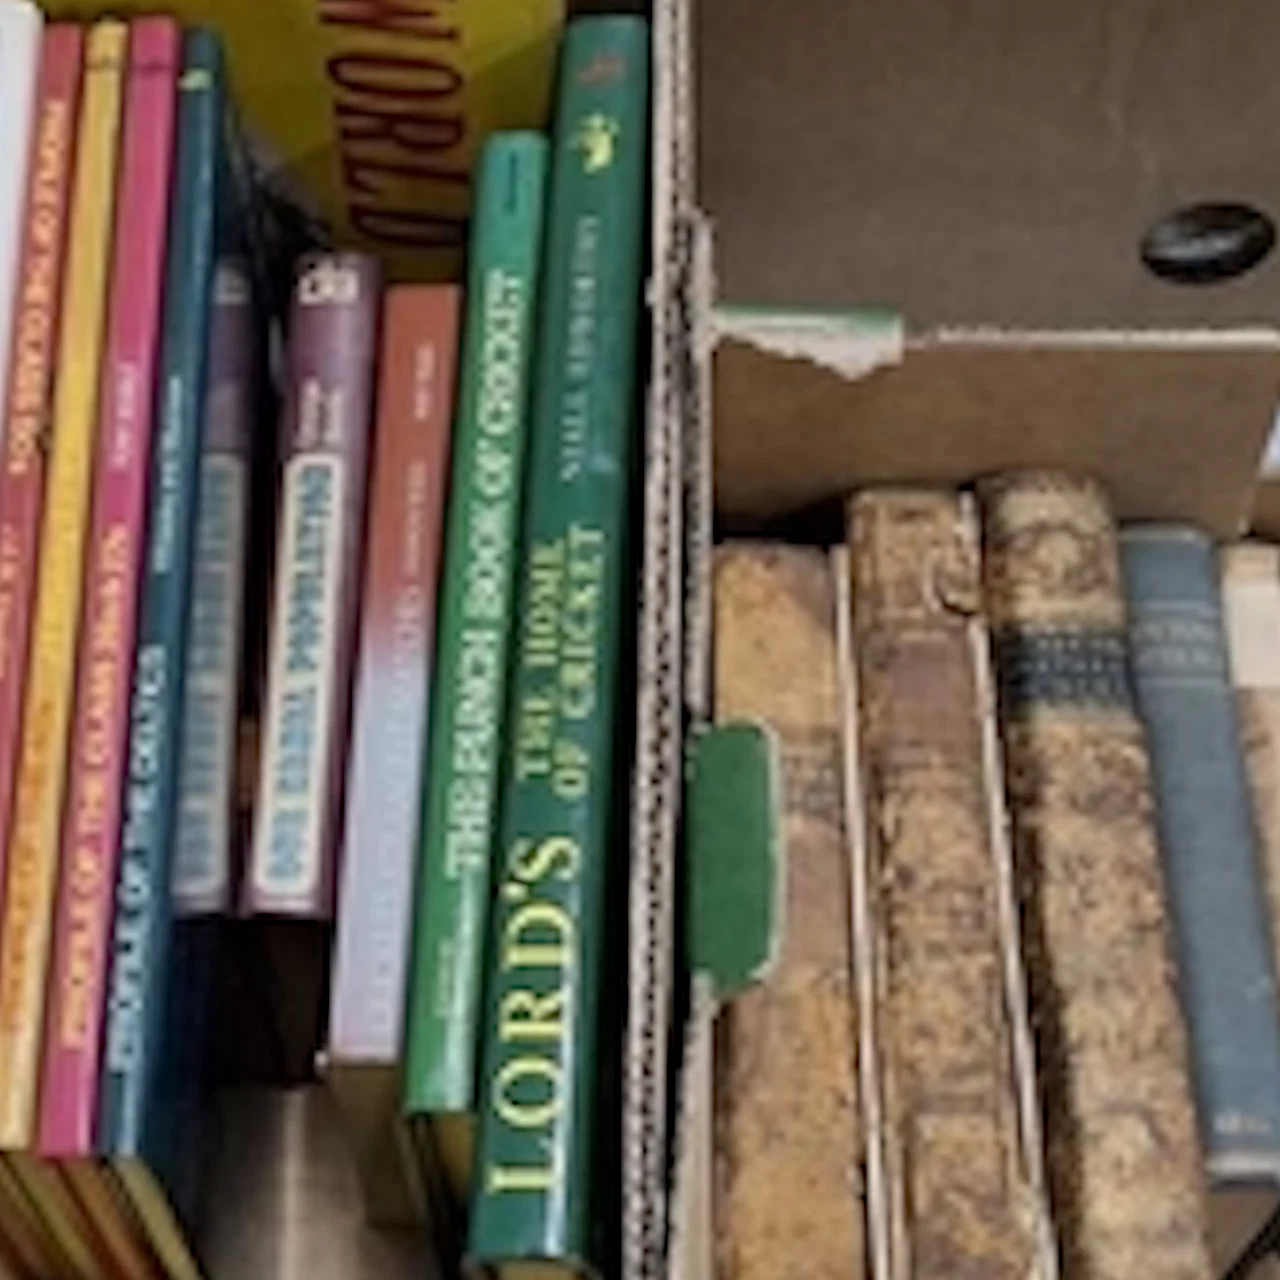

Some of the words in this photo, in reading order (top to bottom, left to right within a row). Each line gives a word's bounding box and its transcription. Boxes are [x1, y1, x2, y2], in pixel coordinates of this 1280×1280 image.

[476, 268, 521, 434] CRICKET
[473, 435, 512, 499] OF
[465, 503, 512, 621] BOOK
[524, 535, 566, 673] HOME
[558, 523, 606, 715] CRICKET
[453, 626, 503, 774] PUNCH
[516, 688, 556, 781] THE
[446, 775, 490, 879] THE
[551, 745, 590, 802] OF
[484, 832, 582, 1197] LORD'S
